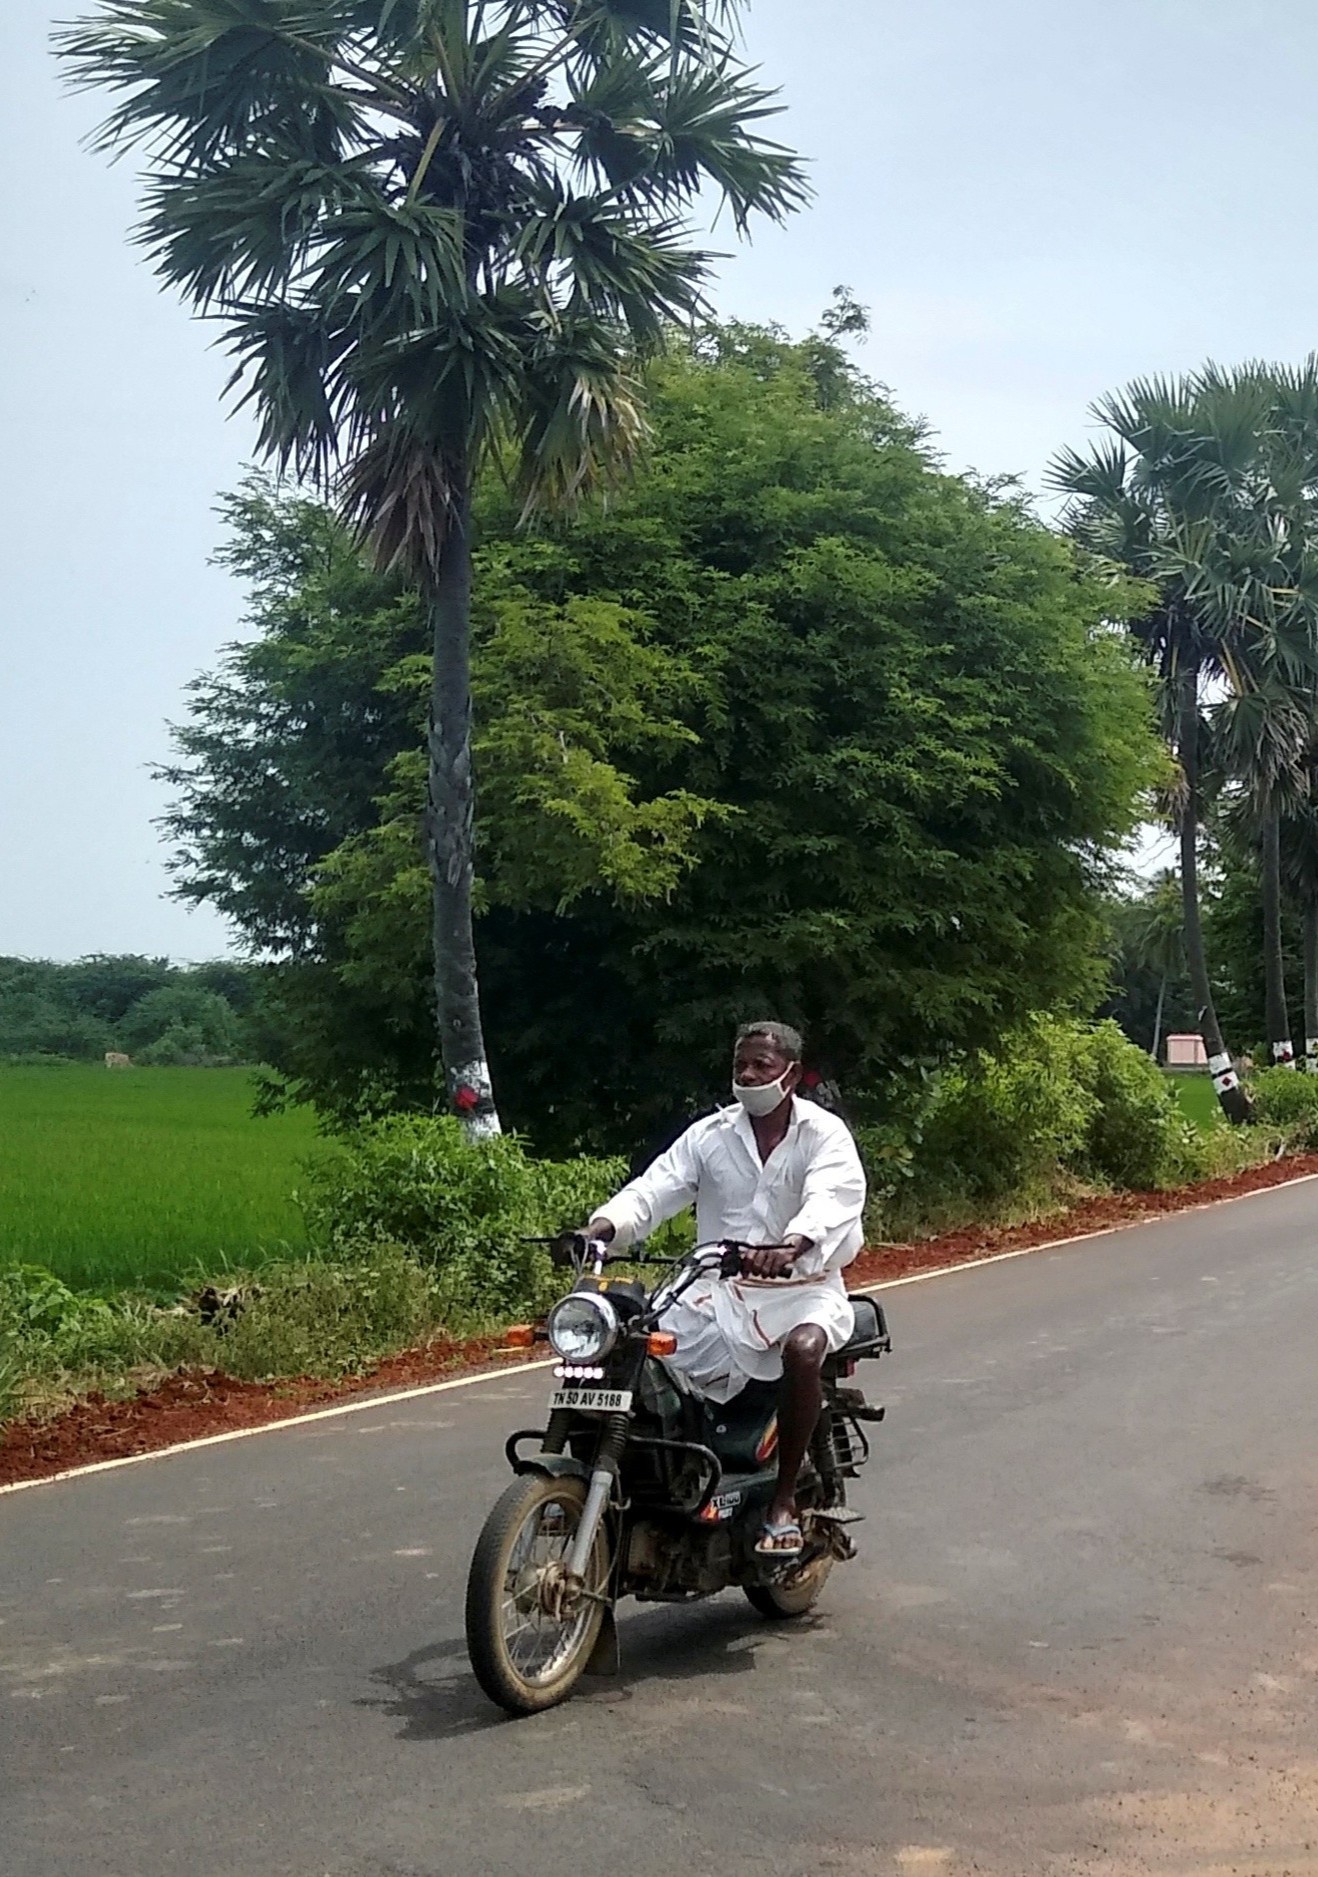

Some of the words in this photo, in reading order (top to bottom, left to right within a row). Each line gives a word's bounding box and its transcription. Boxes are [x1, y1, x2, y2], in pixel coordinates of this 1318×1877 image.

[554, 1392, 566, 1405] TN
[566, 1392, 579, 1405] 50
[580, 1392, 596, 1406] AV
